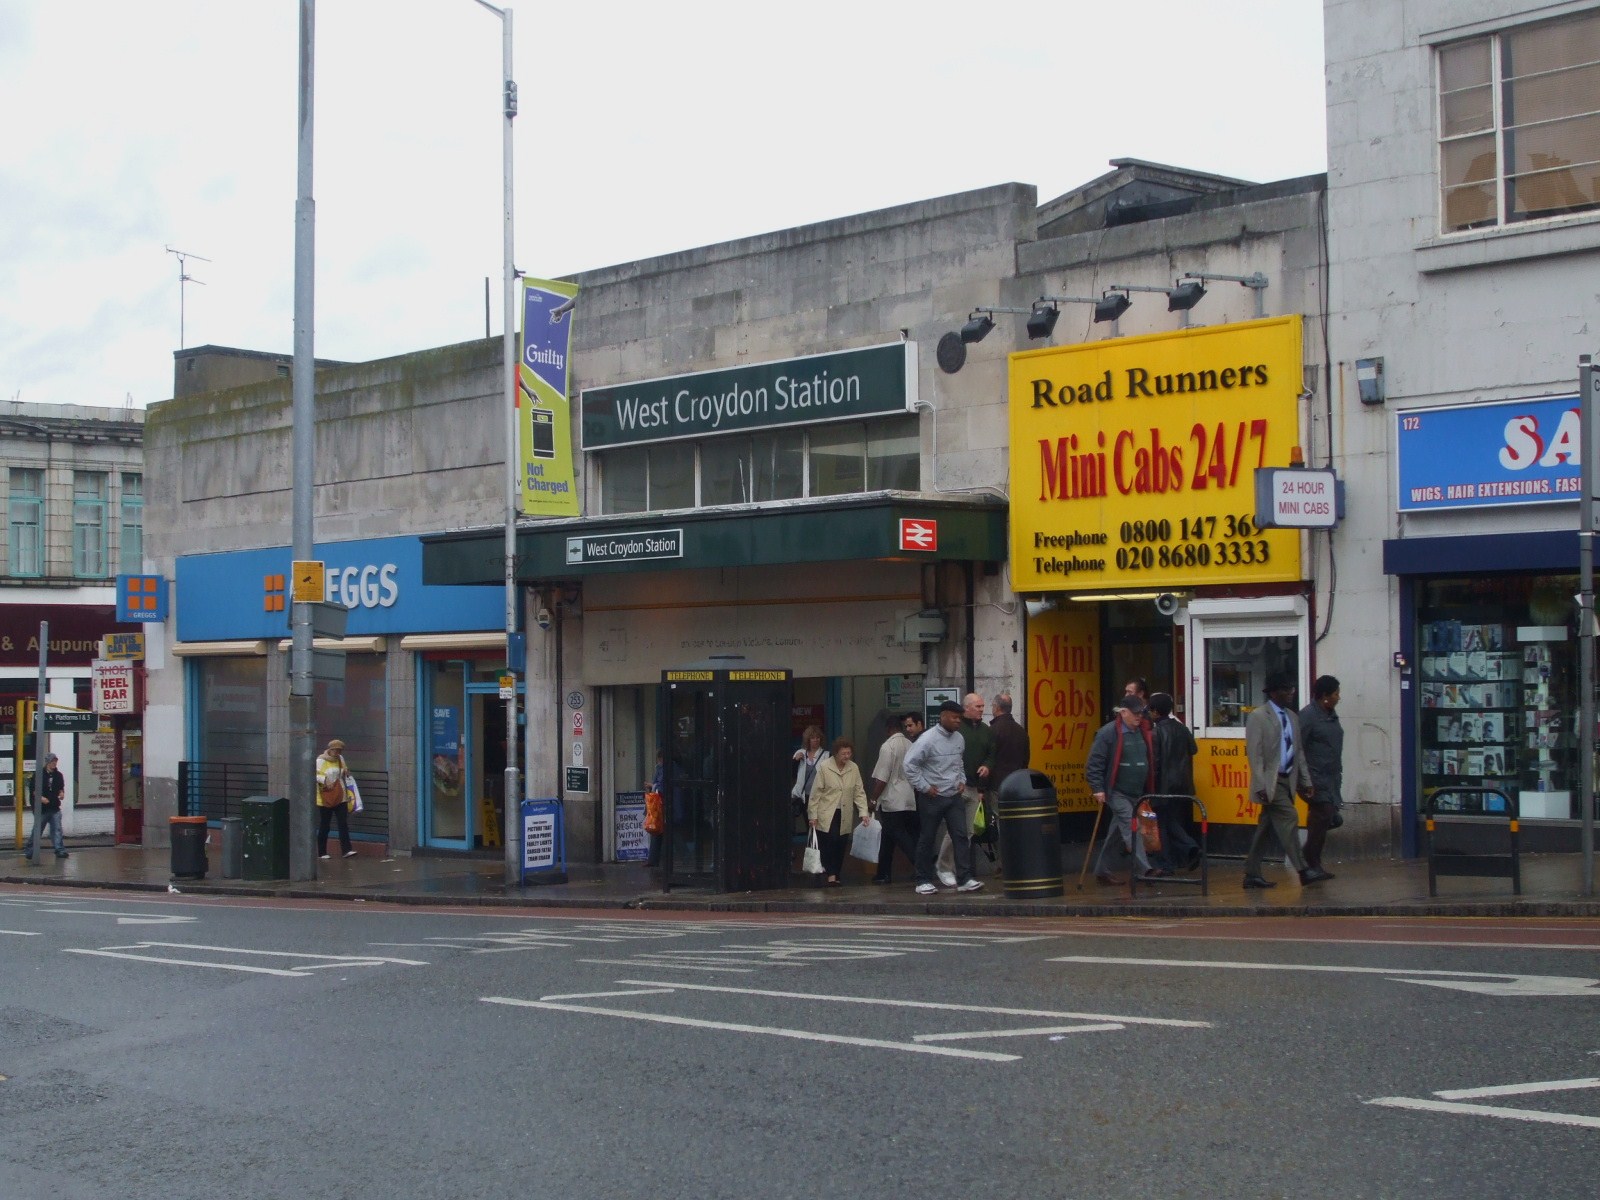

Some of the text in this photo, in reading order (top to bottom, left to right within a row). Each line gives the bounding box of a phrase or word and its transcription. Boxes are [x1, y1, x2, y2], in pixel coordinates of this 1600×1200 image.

[526, 343, 564, 370] Guilty
[1030, 363, 1268, 409] Road Runners
[616, 371, 861, 431] West Croydon Station
[1402, 417, 1420, 431] 172
[526, 462, 544, 477] Not
[1038, 418, 1267, 502] Mini Cabs 24/7
[527, 477, 569, 495] Charged
[1282, 482, 1325, 495] 24 HOUR
[1411, 477, 1581, 502] WIGS, HAIR EXTENSIONS, FAS
[1279, 502, 1329, 515] MINI CABS
[1033, 529, 1108, 551] Freephone
[1120, 518, 1171, 545] 0800
[1179, 516, 1217, 541] 147
[586, 537, 676, 557] West Croydon Station
[1033, 540, 1270, 576] Telephone 020 8680 3333
[290, 563, 399, 609] EGGS
[1, 635, 100, 655] & Aupunc
[1034, 634, 1095, 673] Mini
[100, 678, 128, 689] HEEL
[669, 671, 710, 680] TELEPHONE
[733, 671, 781, 680] TELEPHONE
[103, 689, 127, 700] BAR
[1033, 678, 1095, 718] Cabs
[104, 701, 128, 709] OPEN
[433, 708, 450, 718] SAVE
[1041, 722, 1088, 751] 24/7
[1210, 746, 1239, 757] Road
[1060, 773, 1076, 783] 147
[1211, 764, 1248, 788] Mini
[620, 813, 638, 822] BANK
